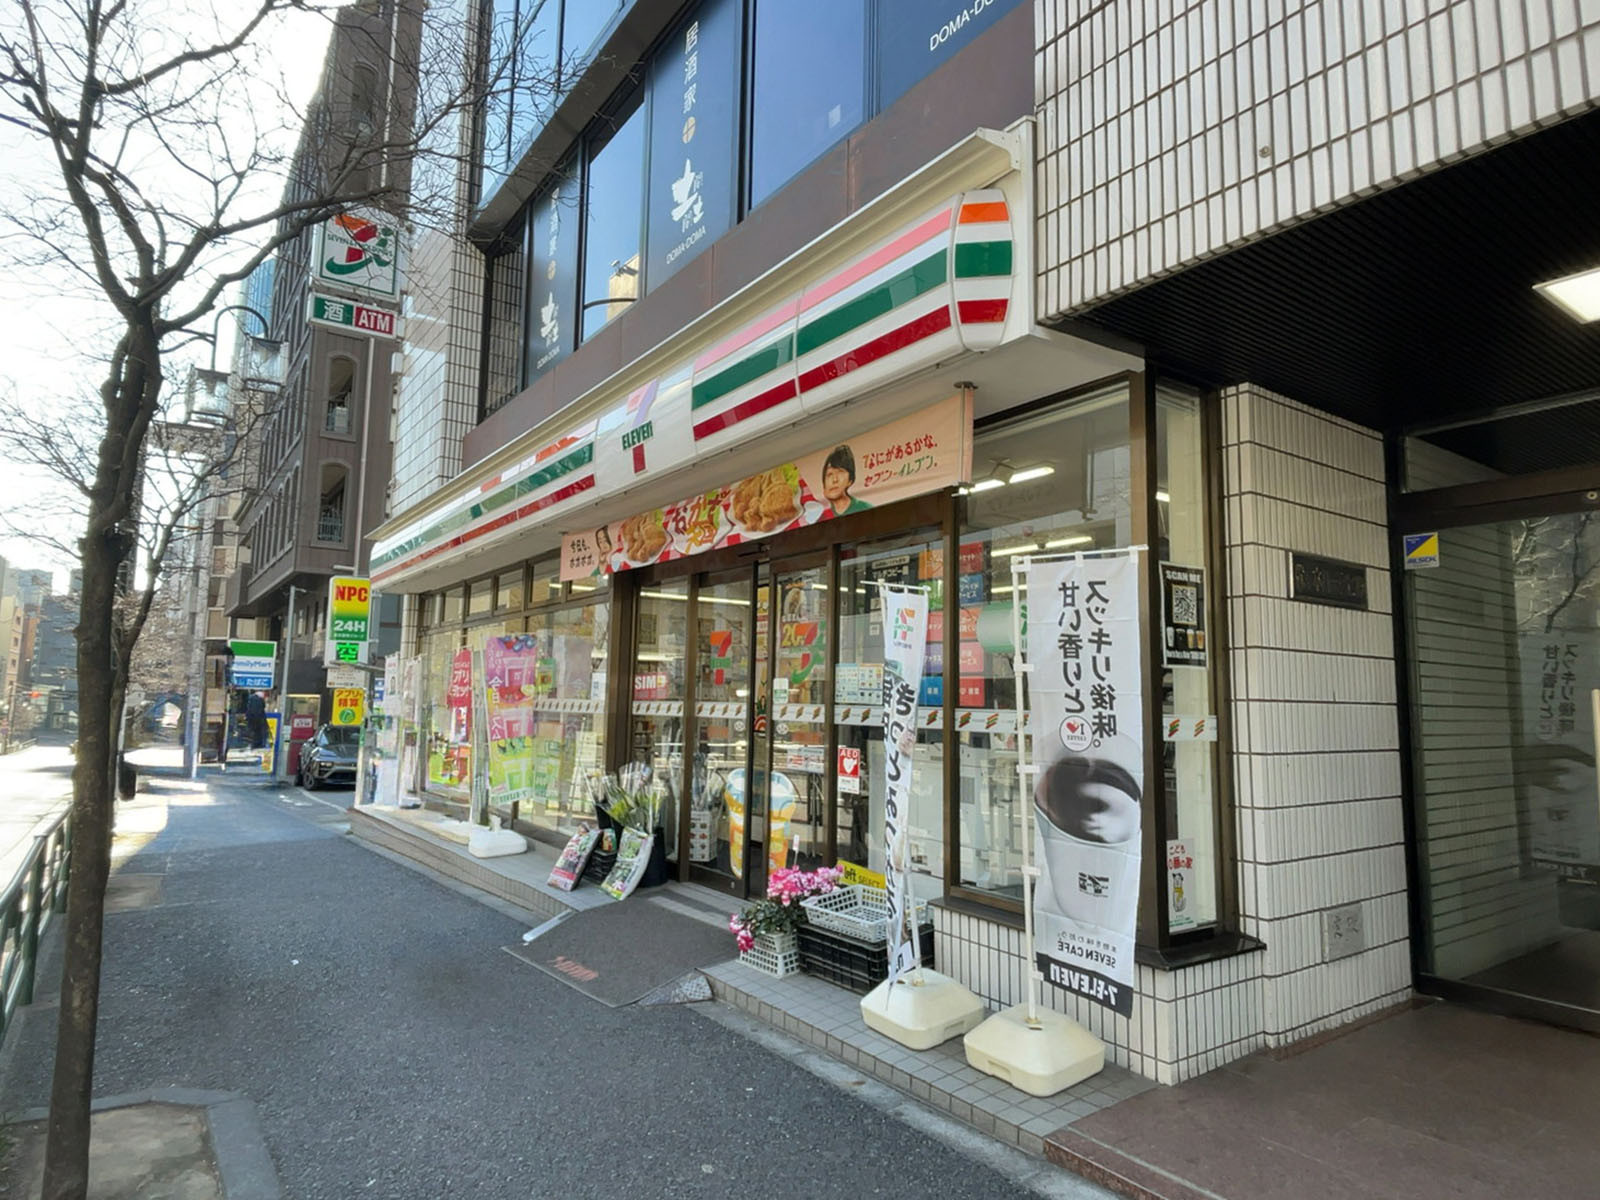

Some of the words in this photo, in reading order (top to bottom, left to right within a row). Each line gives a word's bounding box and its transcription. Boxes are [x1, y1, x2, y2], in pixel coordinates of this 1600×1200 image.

[323, 300, 345, 321] 酒
[358, 308, 390, 332] ATM
[1165, 570, 1188, 581] SCAN
[1189, 573, 1201, 583] ME
[335, 586, 368, 603] NPC
[334, 620, 366, 632] 24H
[336, 642, 360, 664] 空
[839, 749, 859, 758] AED
